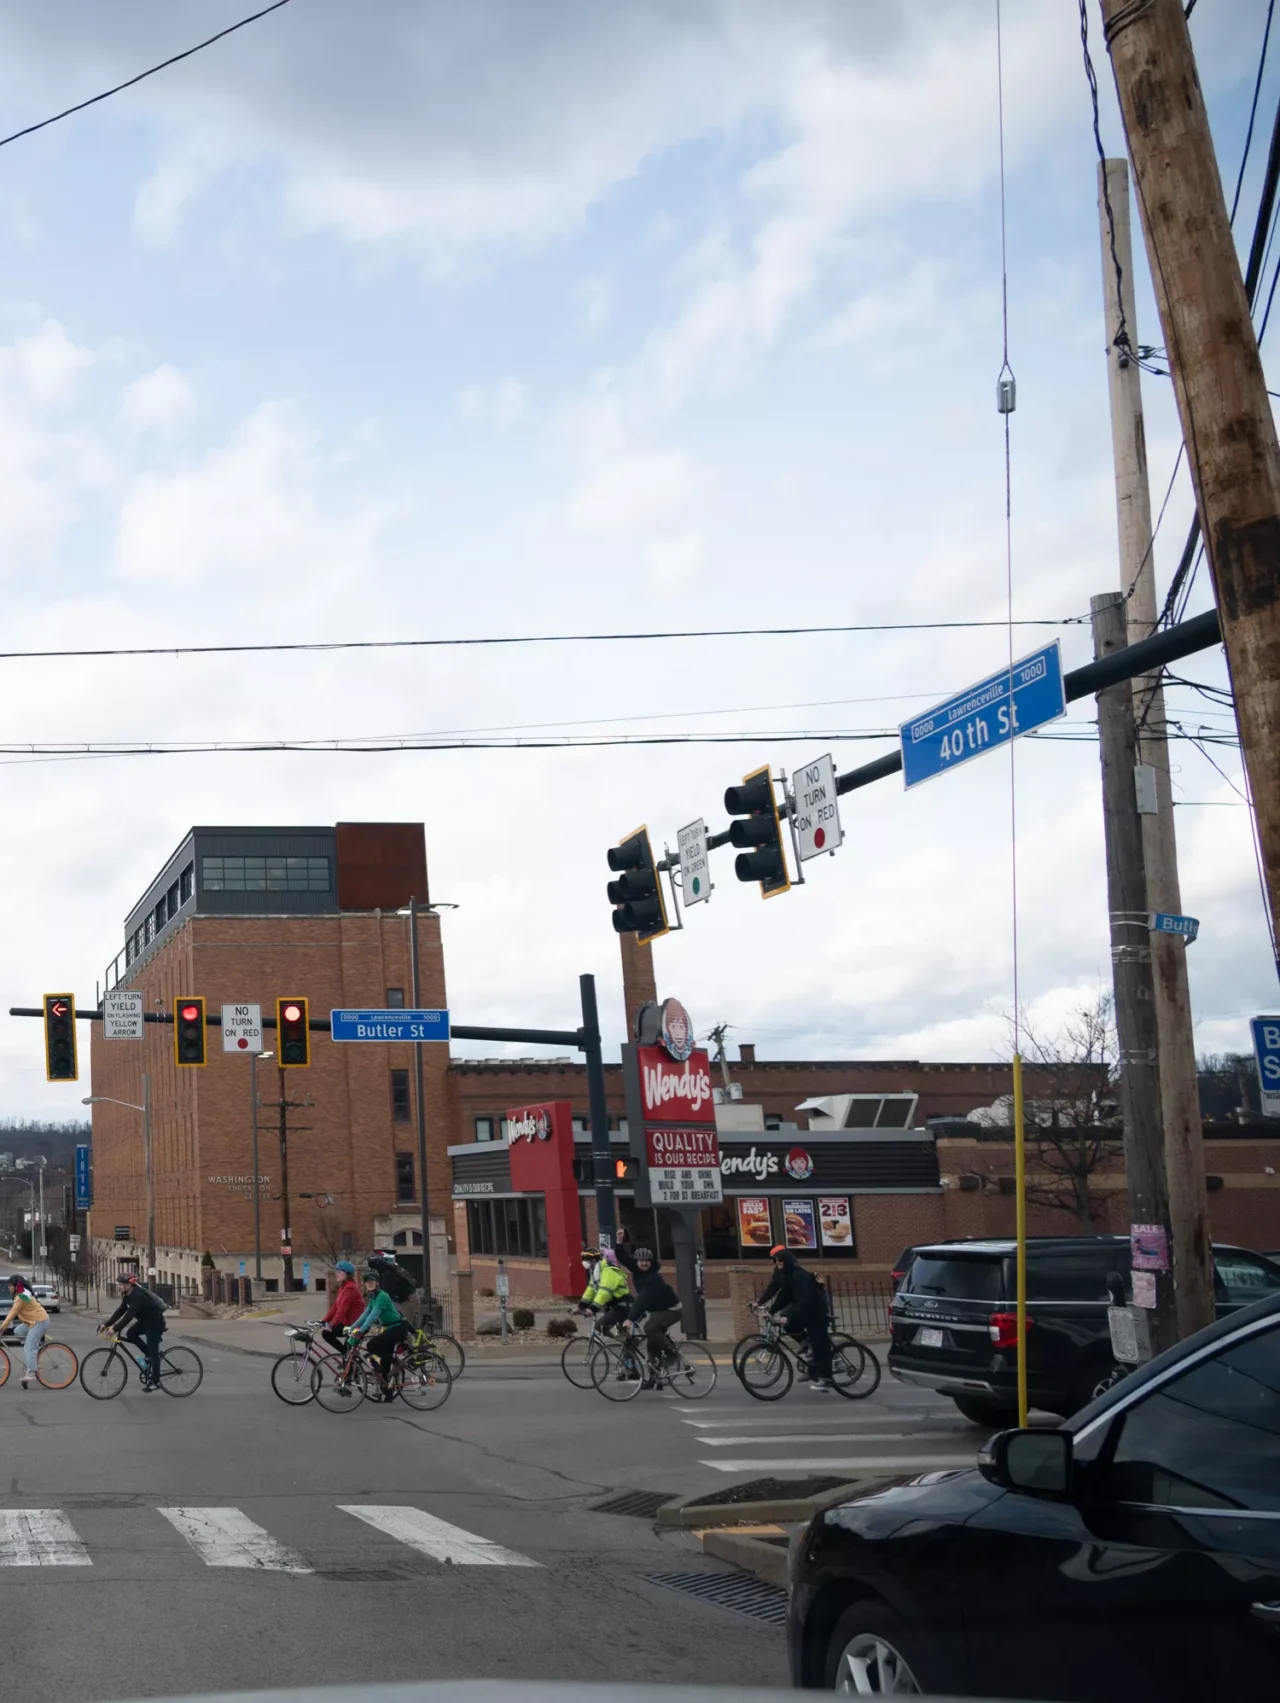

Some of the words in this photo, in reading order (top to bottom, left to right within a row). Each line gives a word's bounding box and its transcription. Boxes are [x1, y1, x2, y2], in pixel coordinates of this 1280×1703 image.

[914, 720, 934, 738] 0000
[948, 684, 1004, 720] Lawrenceville
[1020, 662, 1042, 682] 1000
[940, 716, 989, 760] 40th
[997, 701, 1020, 734] St
[806, 766, 820, 787] NO
[803, 786, 826, 808] TURN
[800, 816, 812, 831] ON
[817, 804, 835, 824] RED
[680, 832, 690, 847] LEFT
[685, 843, 701, 860] YIELD
[683, 865, 691, 876] ON
[691, 859, 706, 874] GREEN
[110, 1003, 136, 1011] YIELD
[235, 1007, 249, 1016] NO
[231, 1018, 253, 1026] TURN
[225, 1029, 237, 1037] ON
[243, 1029, 259, 1037] RED
[357, 1024, 403, 1037] Butler
[410, 1024, 425, 1037] St
[644, 1060, 710, 1111] Wendy's
[507, 1111, 536, 1145] Wendy's
[653, 1132, 714, 1152] QUALITY
[655, 1153, 663, 1164] IS
[665, 1153, 685, 1164] OUR
[687, 1153, 716, 1165] RECIPE
[720, 1147, 778, 1181] endy's
[664, 1170, 676, 1179] RISE
[681, 1170, 692, 1179] AND
[698, 1170, 712, 1179] SHINE
[658, 1181, 674, 1190] BUILD
[680, 1181, 694, 1189] YOUR
[703, 1181, 714, 1189] OWN
[663, 1191, 668, 1200] 2
[670, 1191, 680, 1200] FOR
[691, 1191, 719, 1200] BREAKFAST
[821, 1204, 831, 1216] 2
[1133, 1224, 1159, 1233] SALE
